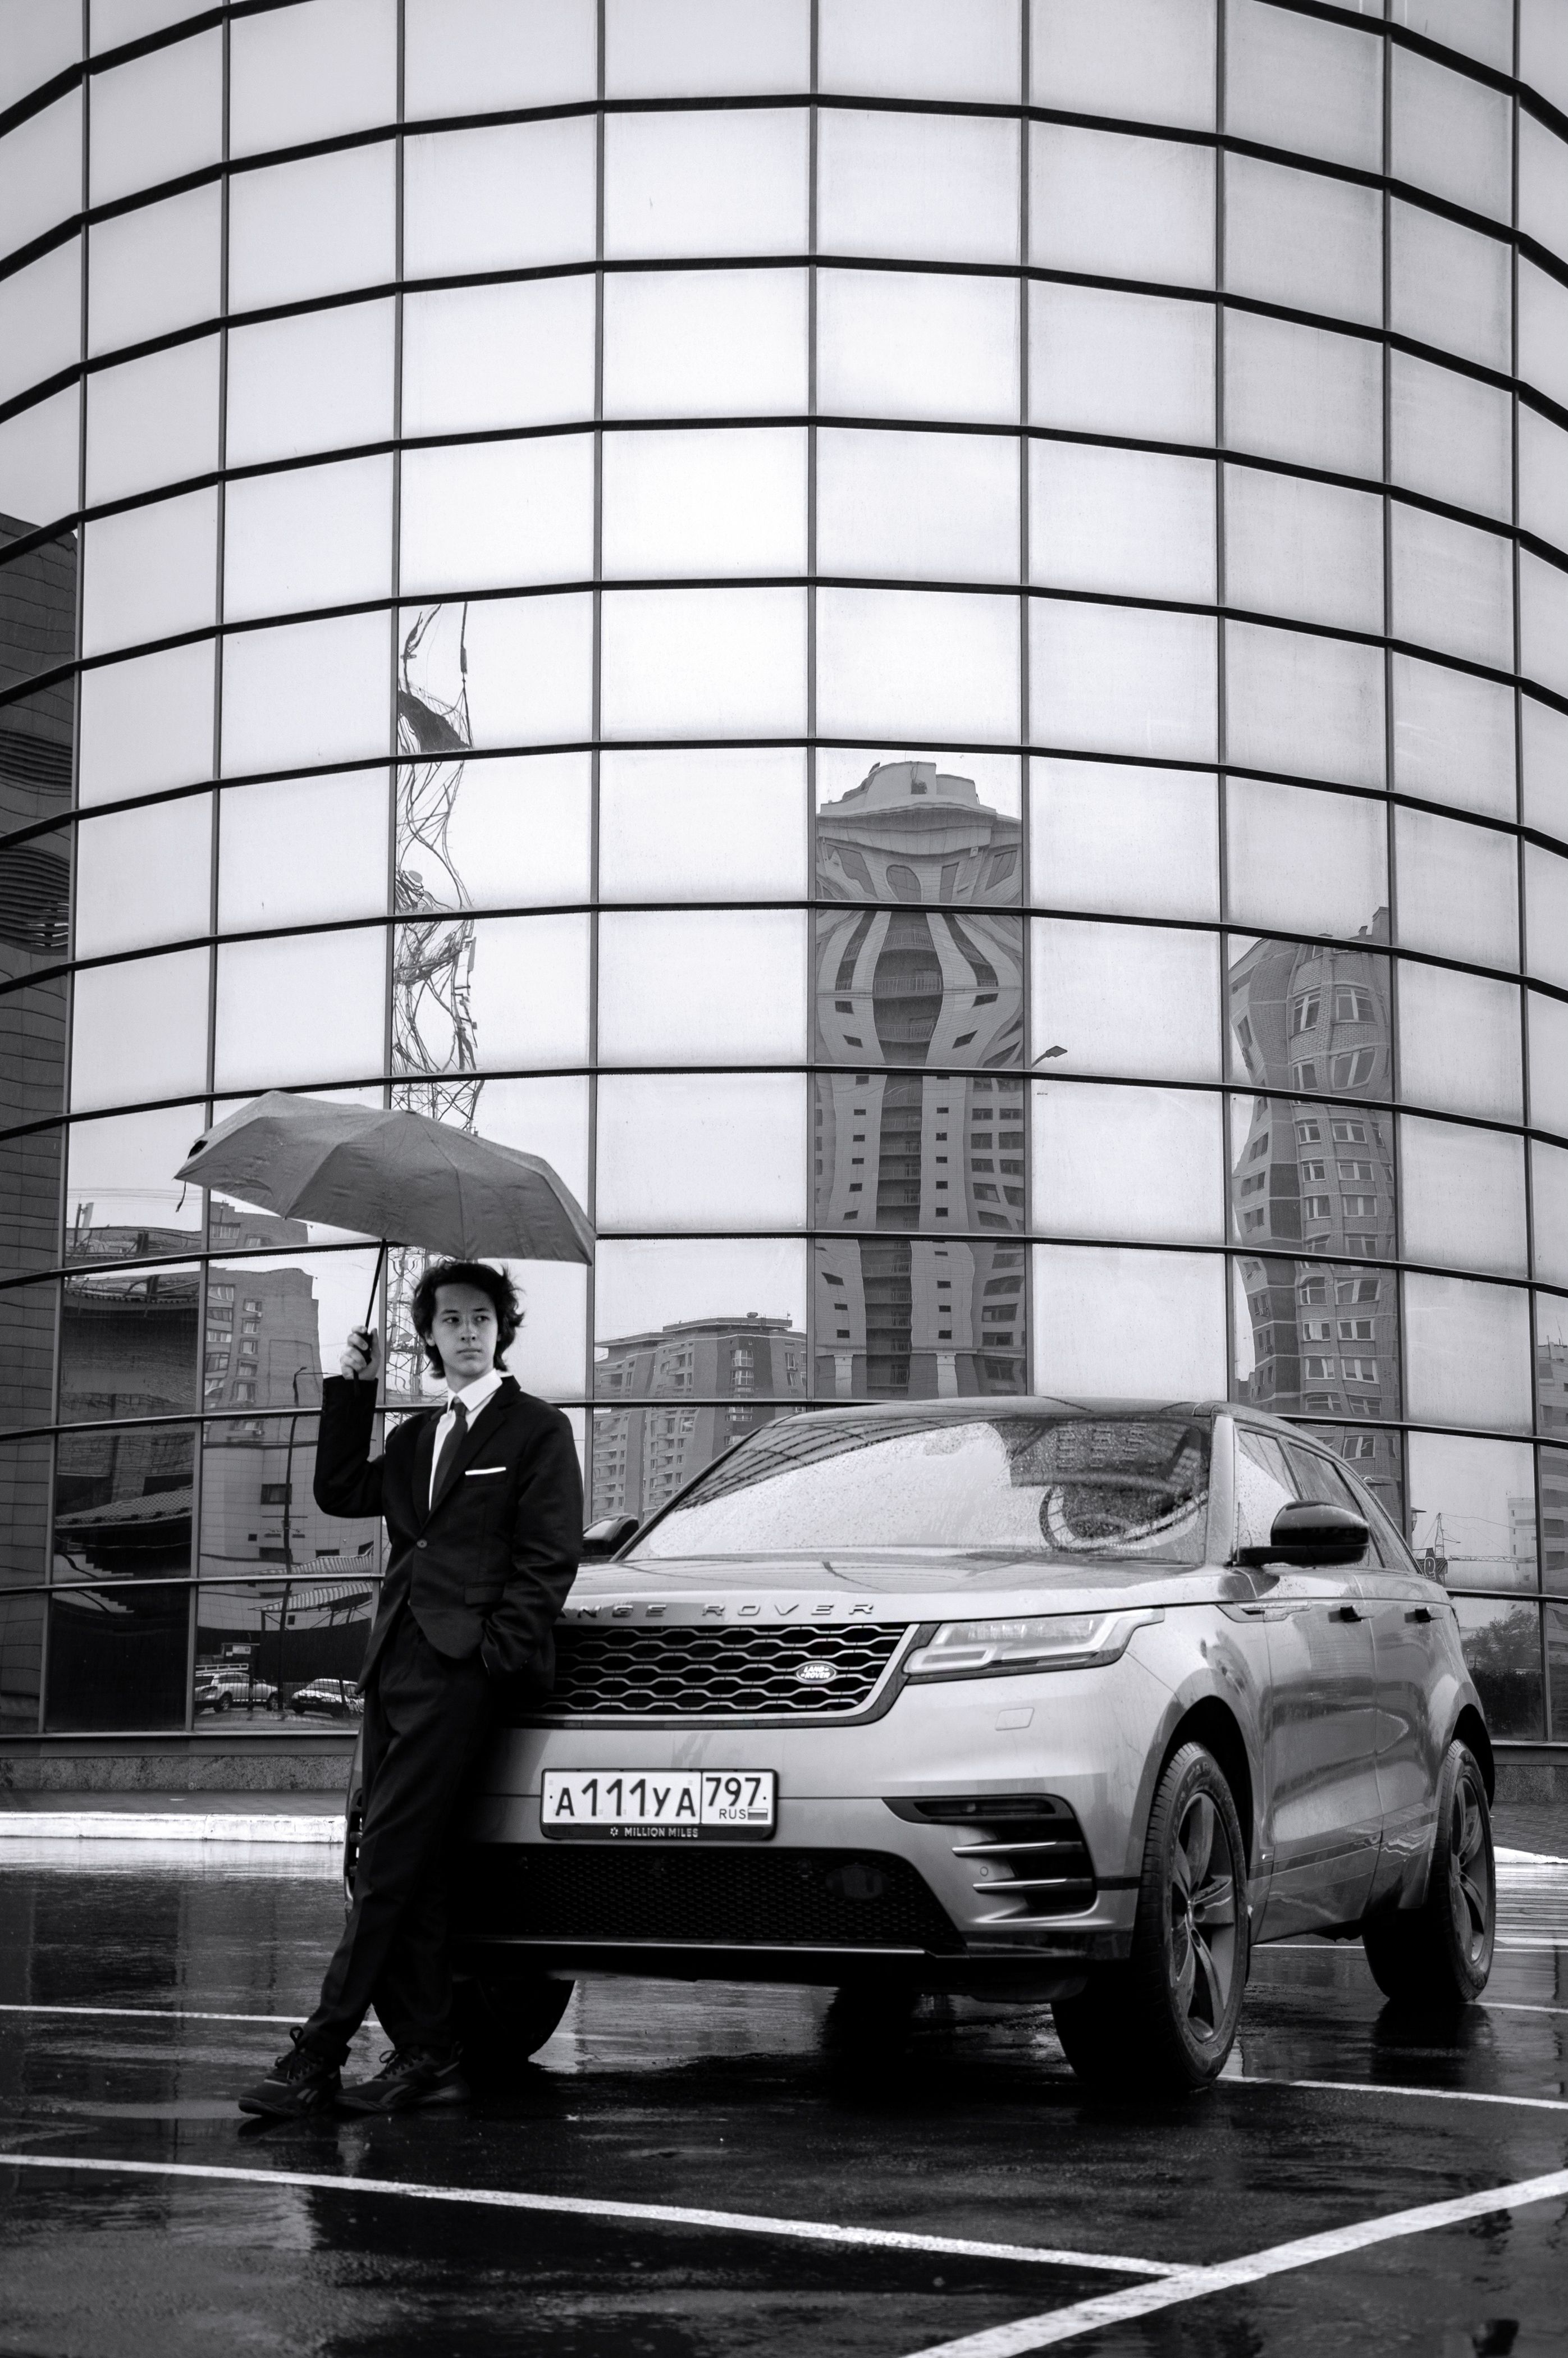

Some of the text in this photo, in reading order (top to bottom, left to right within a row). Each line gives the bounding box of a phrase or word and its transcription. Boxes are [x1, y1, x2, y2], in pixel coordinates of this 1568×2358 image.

[702, 1603, 874, 1616] ROVER
[706, 1776, 761, 1807] 797
[719, 1808, 746, 1820] RUS
[624, 1827, 698, 1838] MILLION MILES
